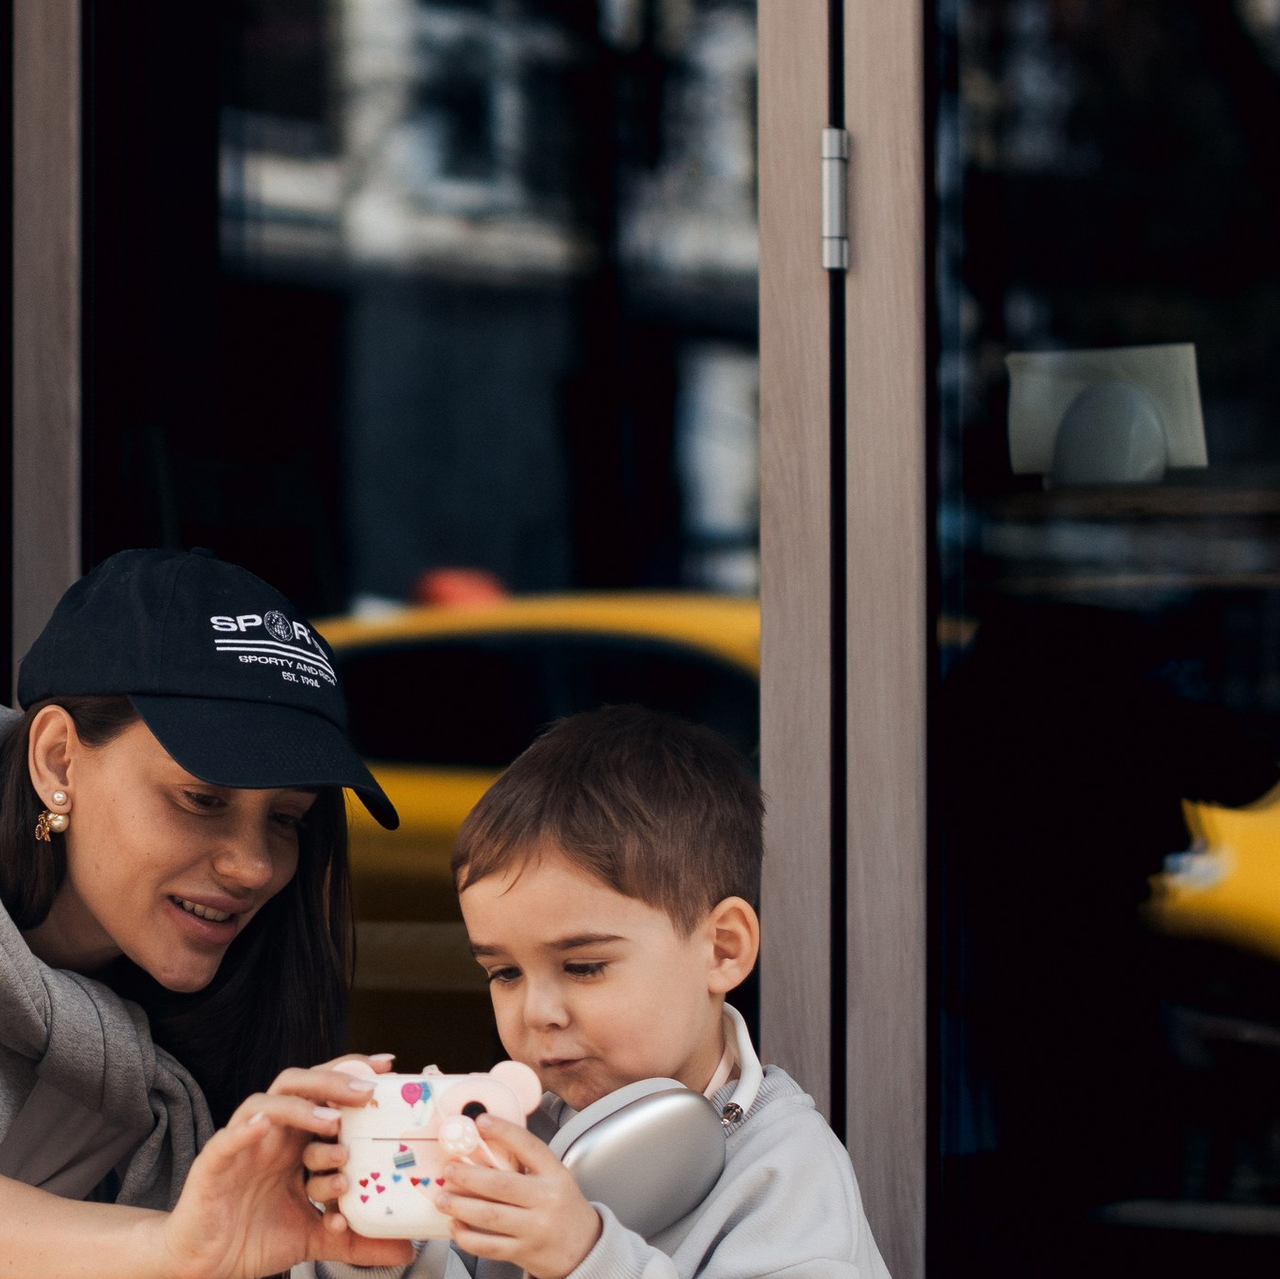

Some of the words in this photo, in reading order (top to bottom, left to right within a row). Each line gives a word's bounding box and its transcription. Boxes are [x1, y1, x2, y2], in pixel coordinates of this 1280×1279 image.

[238, 655, 293, 668] SPORTY
[296, 662, 318, 675] AND
[281, 671, 299, 683] EST.
[300, 675, 321, 688] 1994
